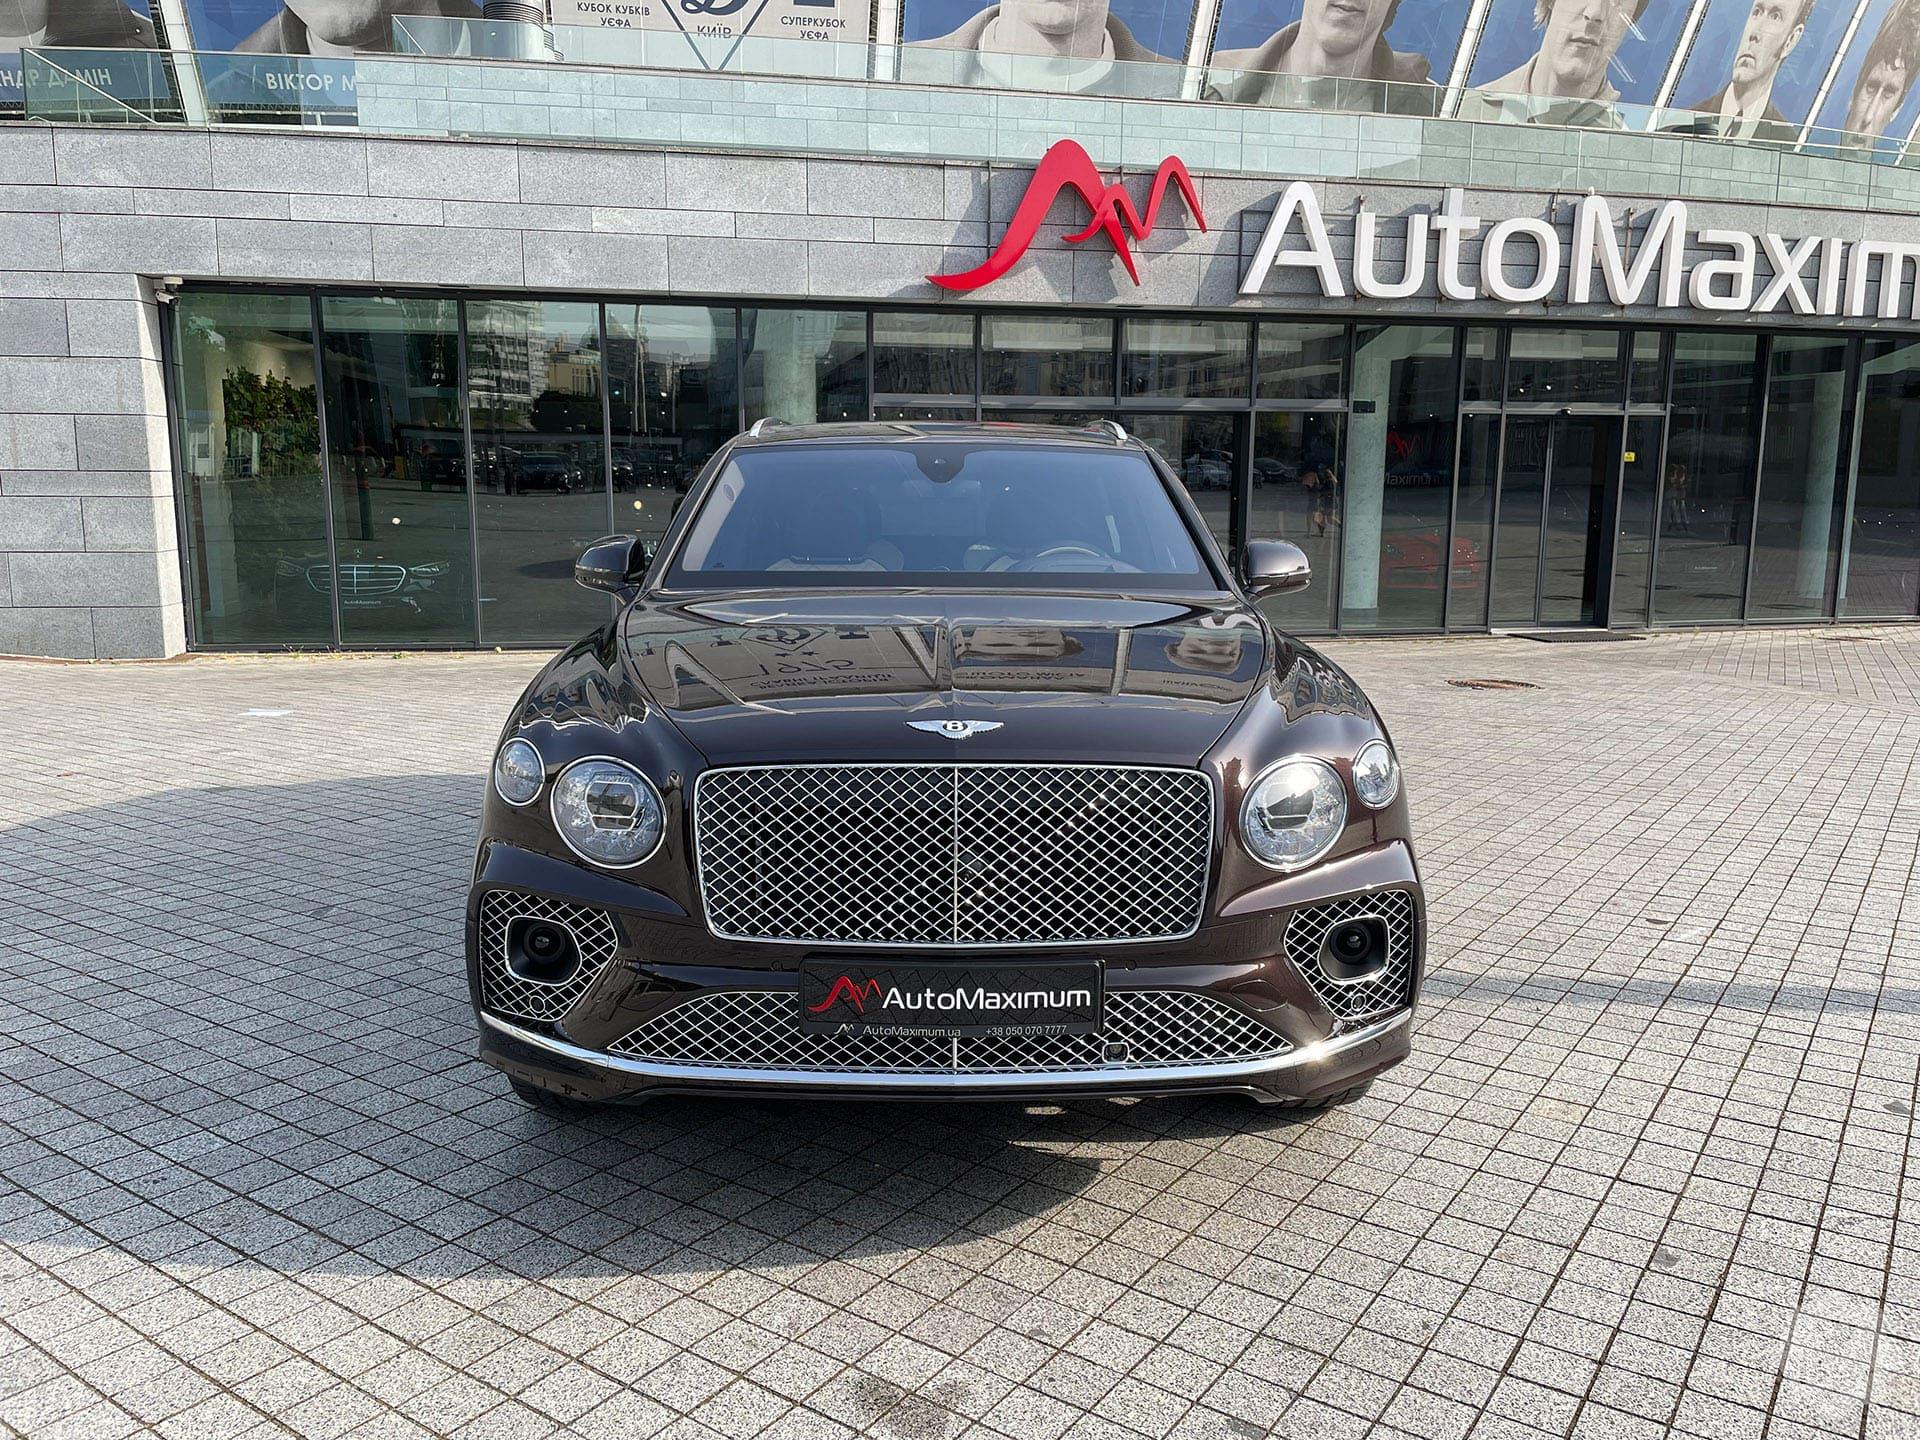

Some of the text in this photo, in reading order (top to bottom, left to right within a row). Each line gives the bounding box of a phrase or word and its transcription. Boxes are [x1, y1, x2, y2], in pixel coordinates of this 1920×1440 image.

[577, 2, 651, 16] КУБОК КУБКІВ
[600, 17, 632, 28] УЄФА
[780, 15, 846, 29] СУПЕРКУБОК
[697, 22, 733, 39] КИЇВ
[799, 30, 830, 41] УЄФА
[0, 68, 40, 88] НДР
[265, 72, 334, 91] ВІКТОР
[882, 987, 1091, 1011] AutoMaximum
[862, 1025, 961, 1037] AutoMaximum.ua
[986, 1025, 1067, 1036] +38 050 070 7777
